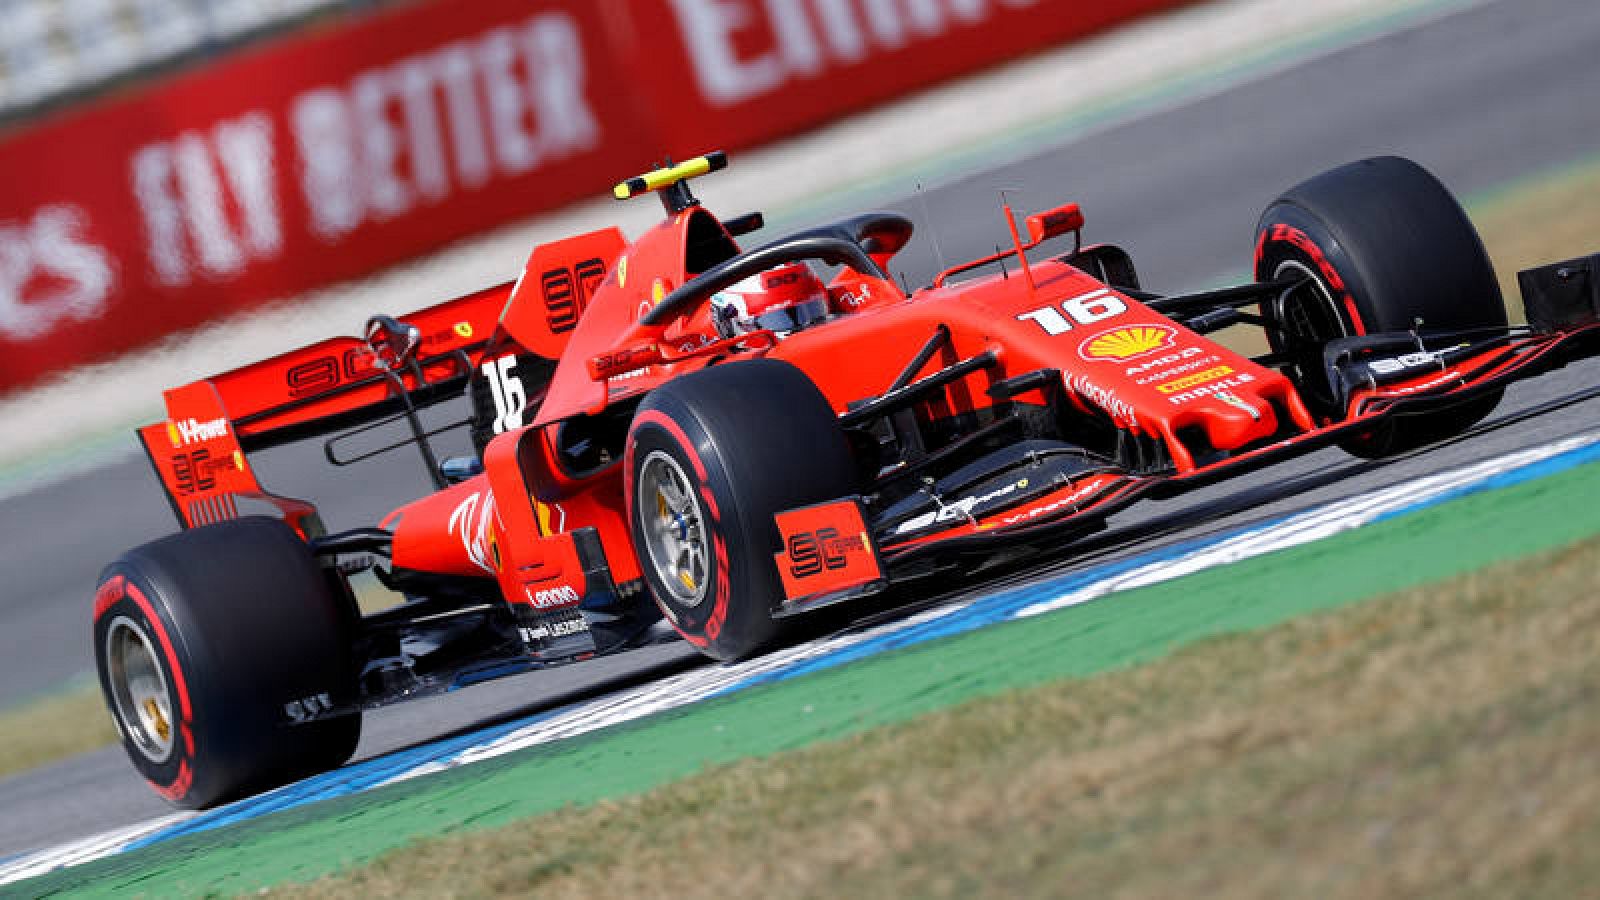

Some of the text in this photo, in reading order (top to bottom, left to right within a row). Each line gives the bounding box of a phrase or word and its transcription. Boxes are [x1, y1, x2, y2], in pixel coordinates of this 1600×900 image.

[132, 110, 282, 286] FLY
[293, 13, 598, 238] BETTER
[1014, 288, 1129, 337] 16
[481, 354, 527, 434] 16
[177, 417, 227, 445] V-Power
[525, 584, 580, 610] Lenovo
